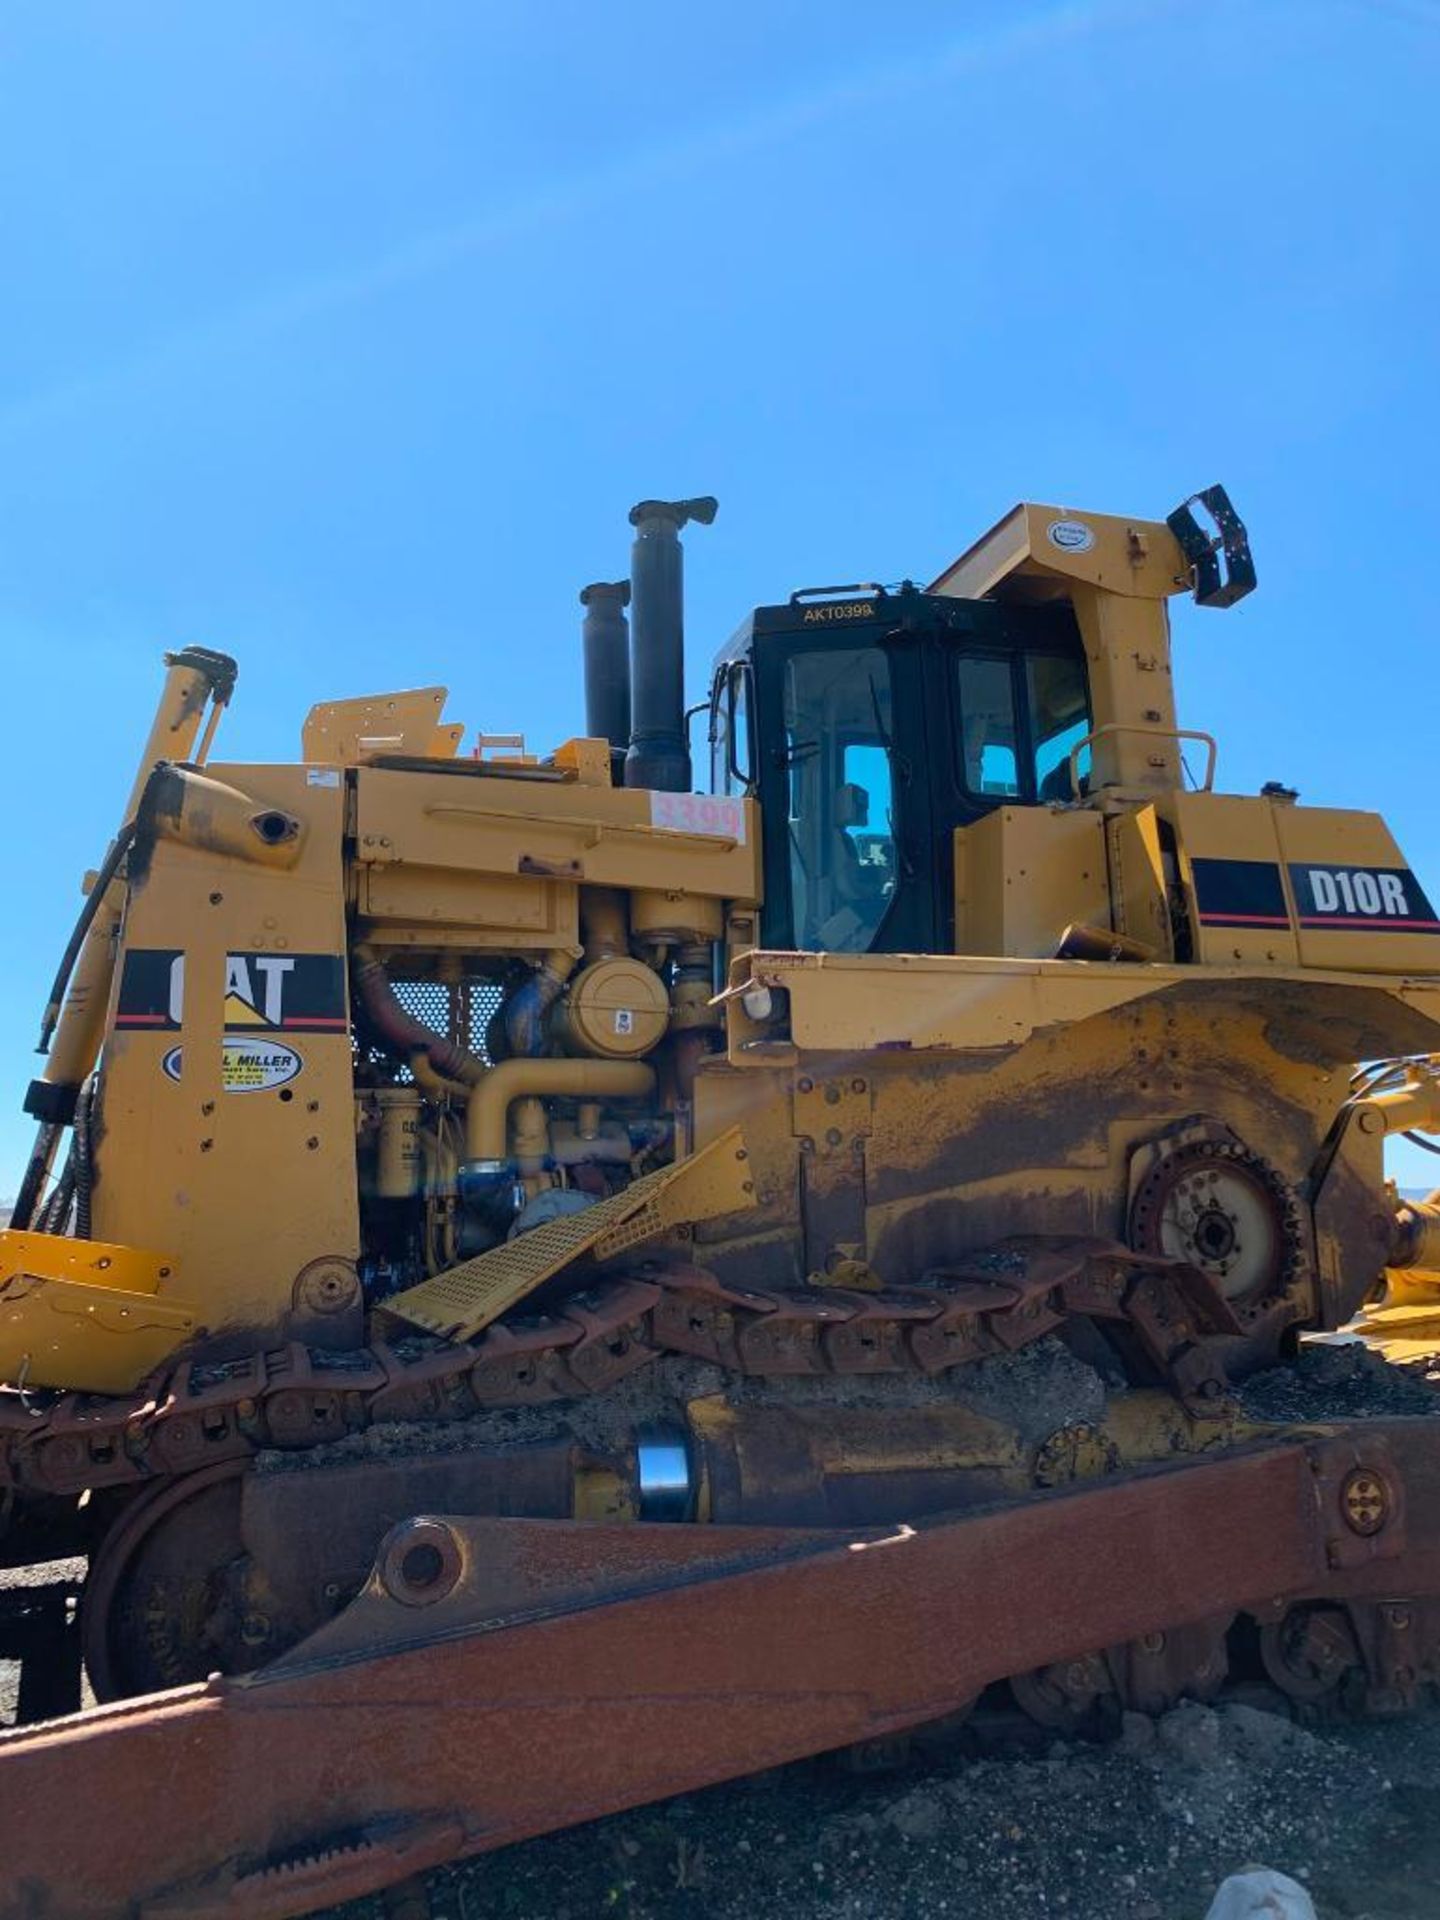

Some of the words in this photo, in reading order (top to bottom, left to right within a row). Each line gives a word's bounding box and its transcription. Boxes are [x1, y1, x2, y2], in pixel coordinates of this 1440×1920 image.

[804, 602, 872, 621] AKT0399
[1308, 870, 1409, 915] D10R
[237, 1055, 293, 1067] MILLER
